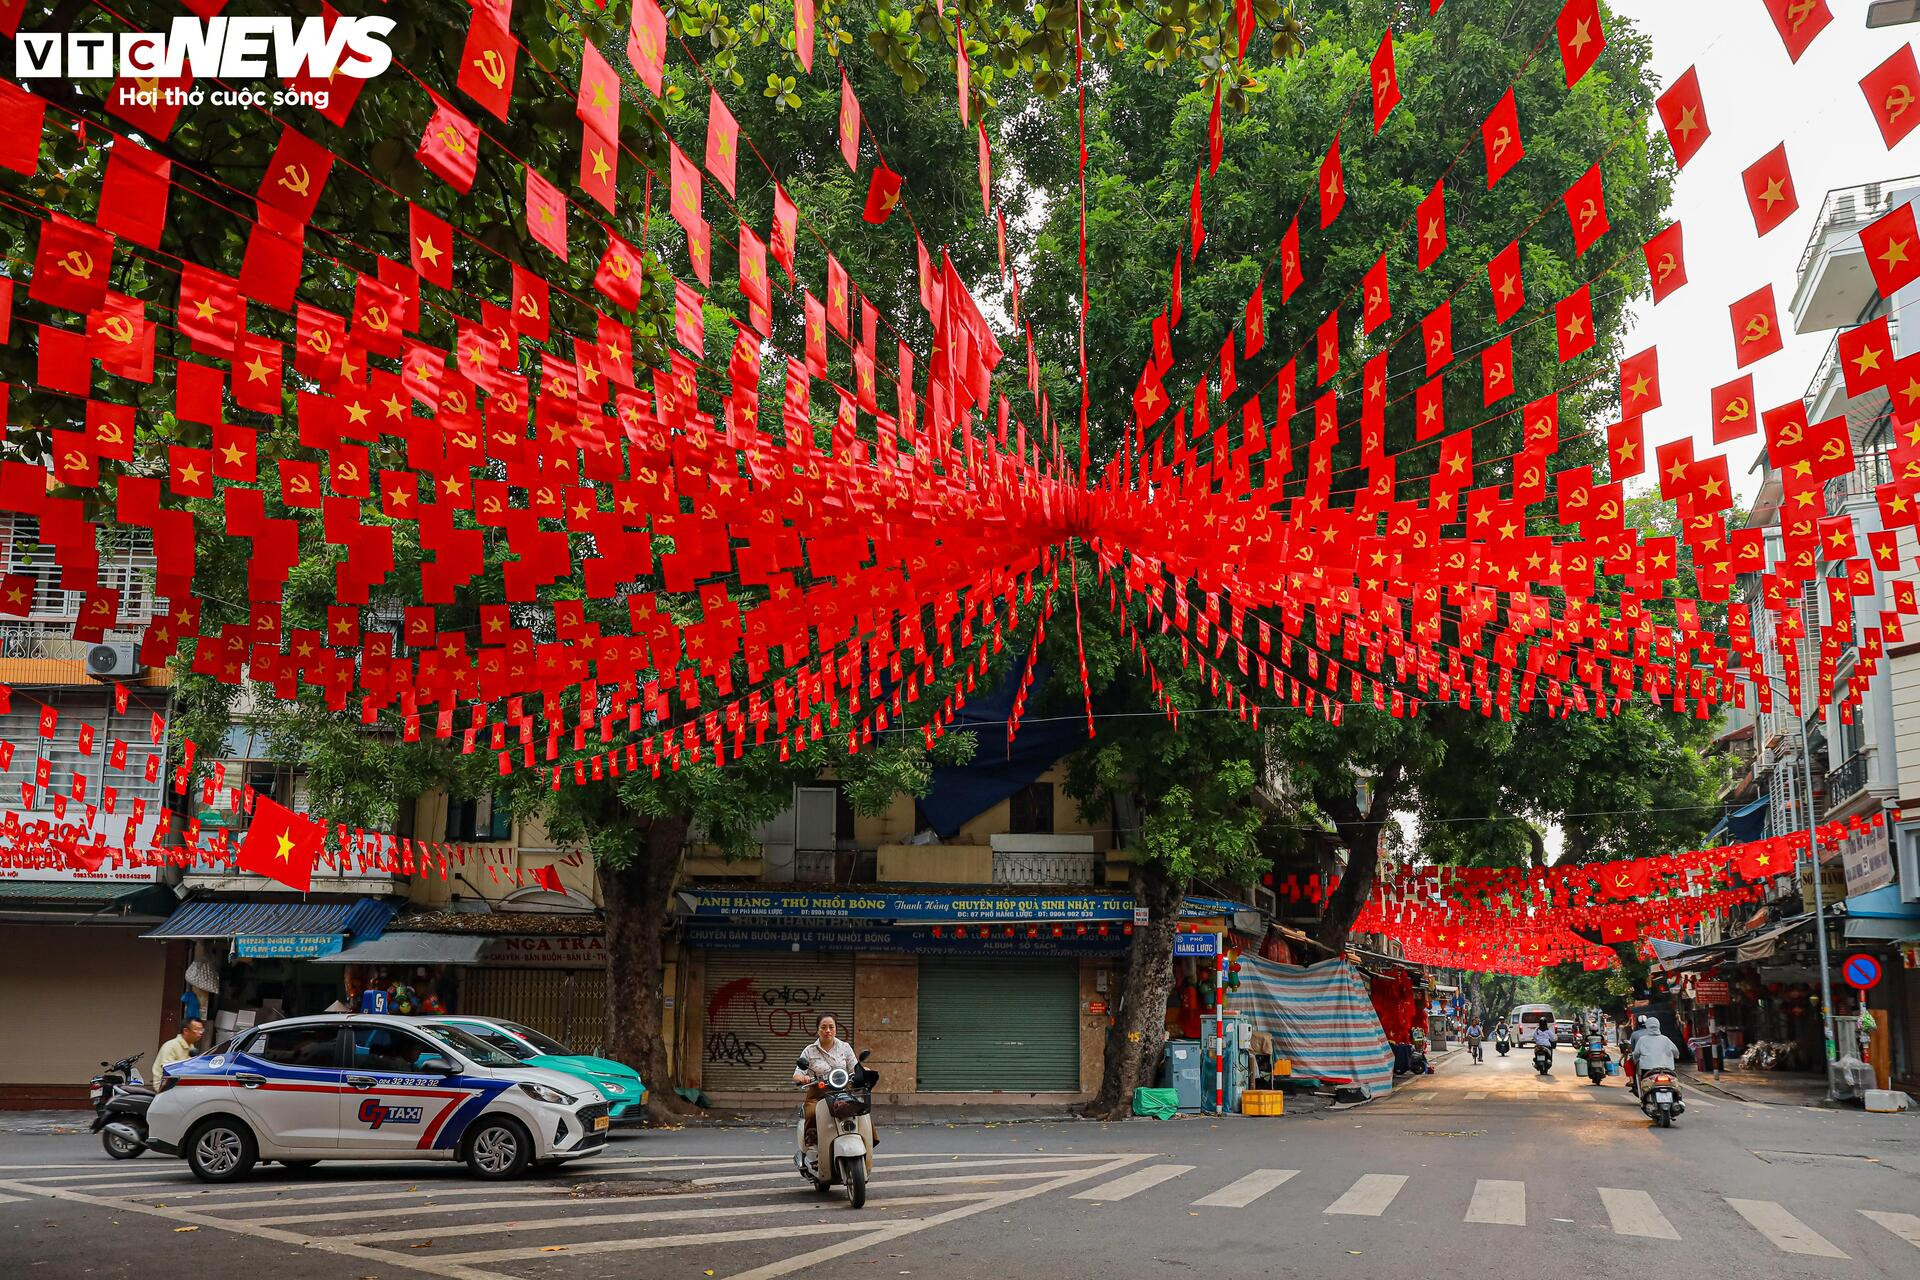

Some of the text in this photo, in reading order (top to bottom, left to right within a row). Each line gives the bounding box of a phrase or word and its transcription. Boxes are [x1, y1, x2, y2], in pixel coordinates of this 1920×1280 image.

[782, 896, 809, 908] THÚ
[813, 895, 846, 909] NHỒI
[848, 896, 887, 910] BÔNG
[894, 901, 922, 910] Thanh
[952, 898, 1136, 912] CHUYÊN HỘP QUÀ SINH NHẬT TÚI GI
[980, 910, 994, 918] PHỐ
[300, 936, 332, 945] THUẬT
[504, 938, 606, 950] NGA TRA
[1177, 943, 1213, 954] HÀNG LƯỢC
[391, 1077, 403, 1085] 32
[403, 1078, 415, 1086] 32
[415, 1079, 427, 1087] 32
[427, 1079, 440, 1087] 32
[388, 1107, 423, 1120] TAXI
